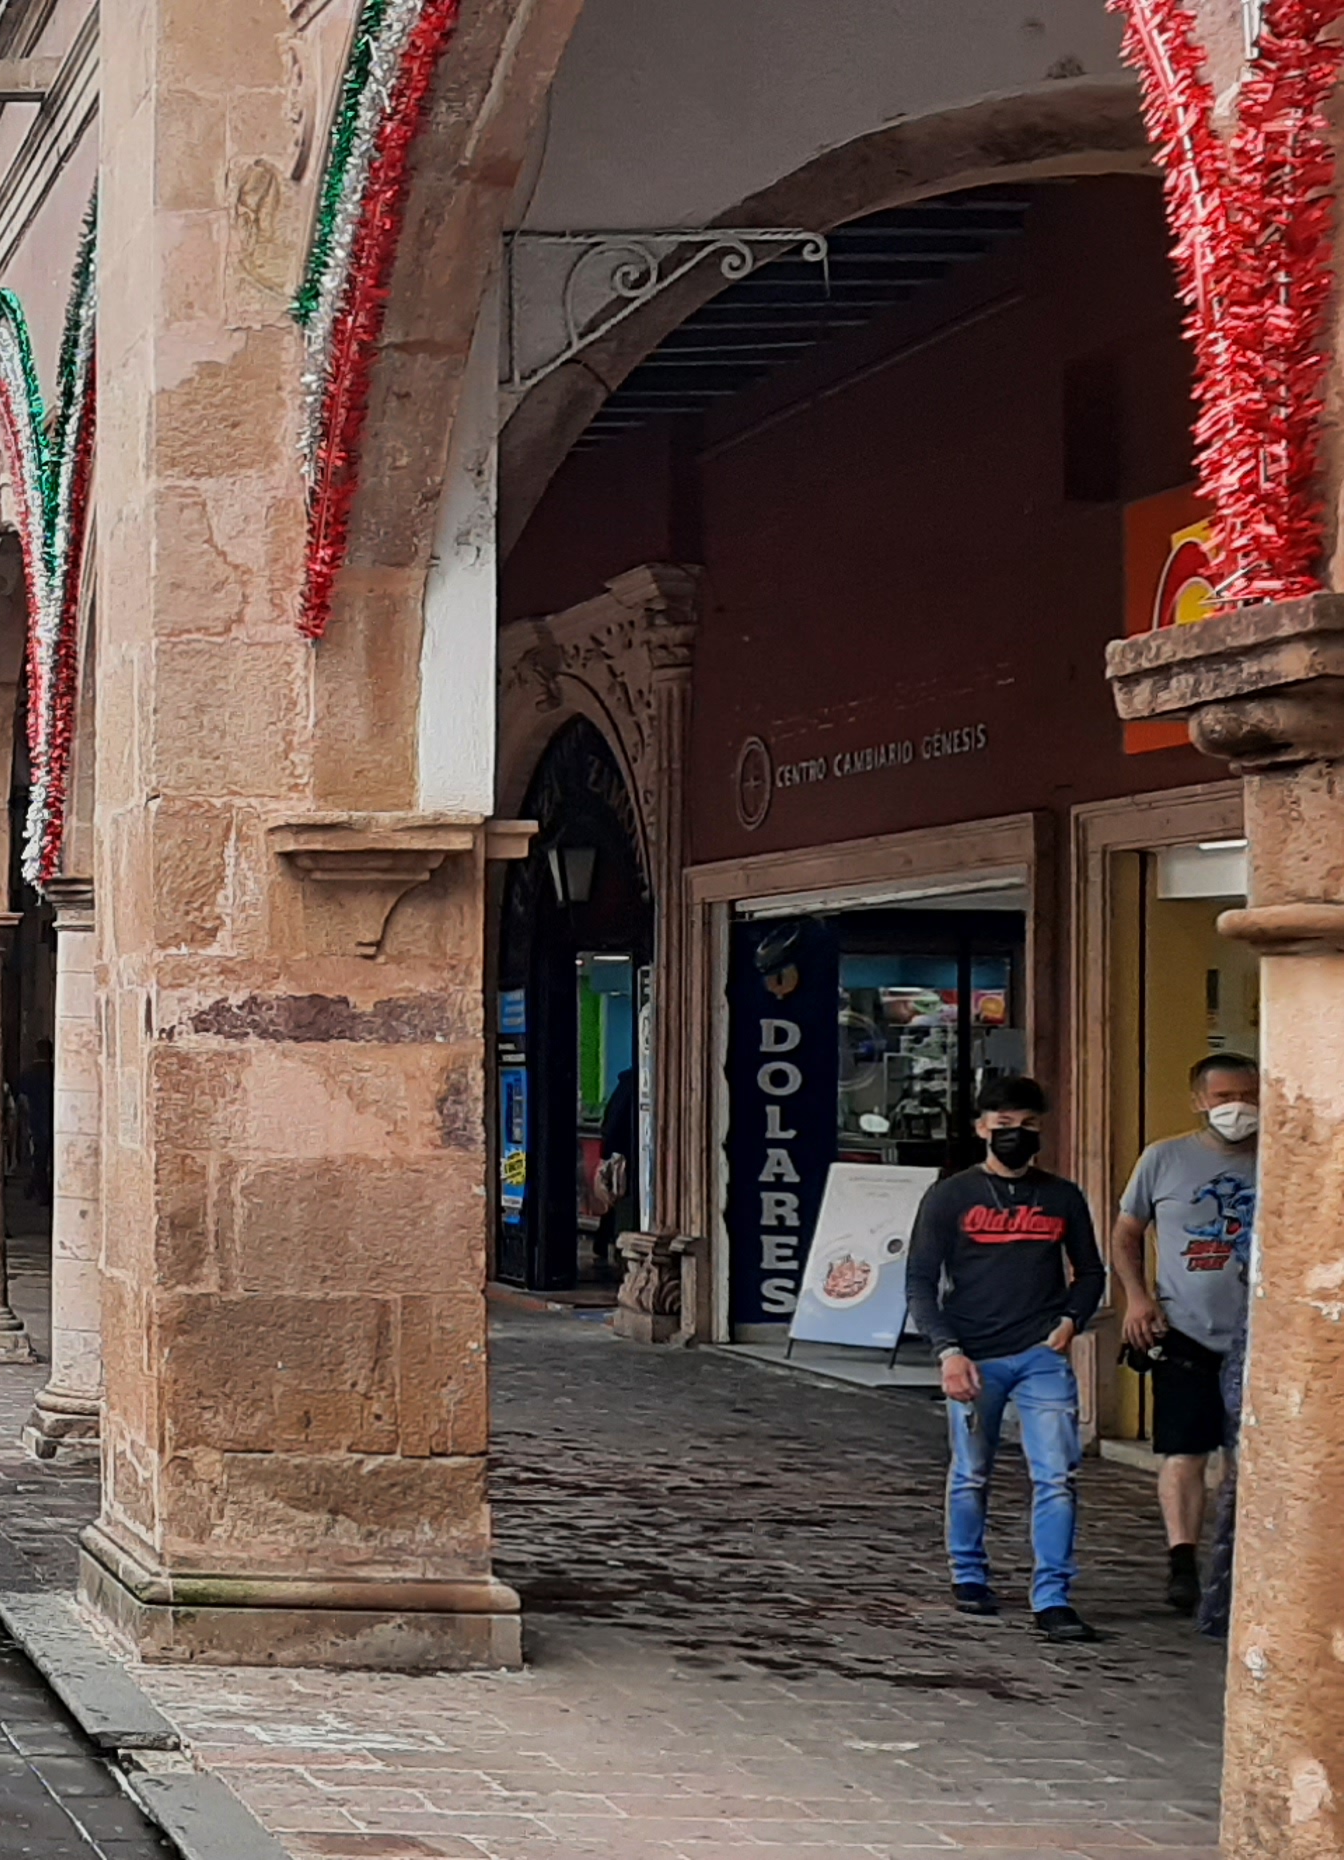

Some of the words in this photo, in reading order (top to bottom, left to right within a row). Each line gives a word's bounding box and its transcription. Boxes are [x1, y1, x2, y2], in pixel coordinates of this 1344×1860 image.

[775, 757, 827, 788] CENTRO
[833, 740, 913, 778] CAMBIARIO
[756, 1018, 803, 1314] DOLARES
[963, 1205, 1008, 1232] Old
